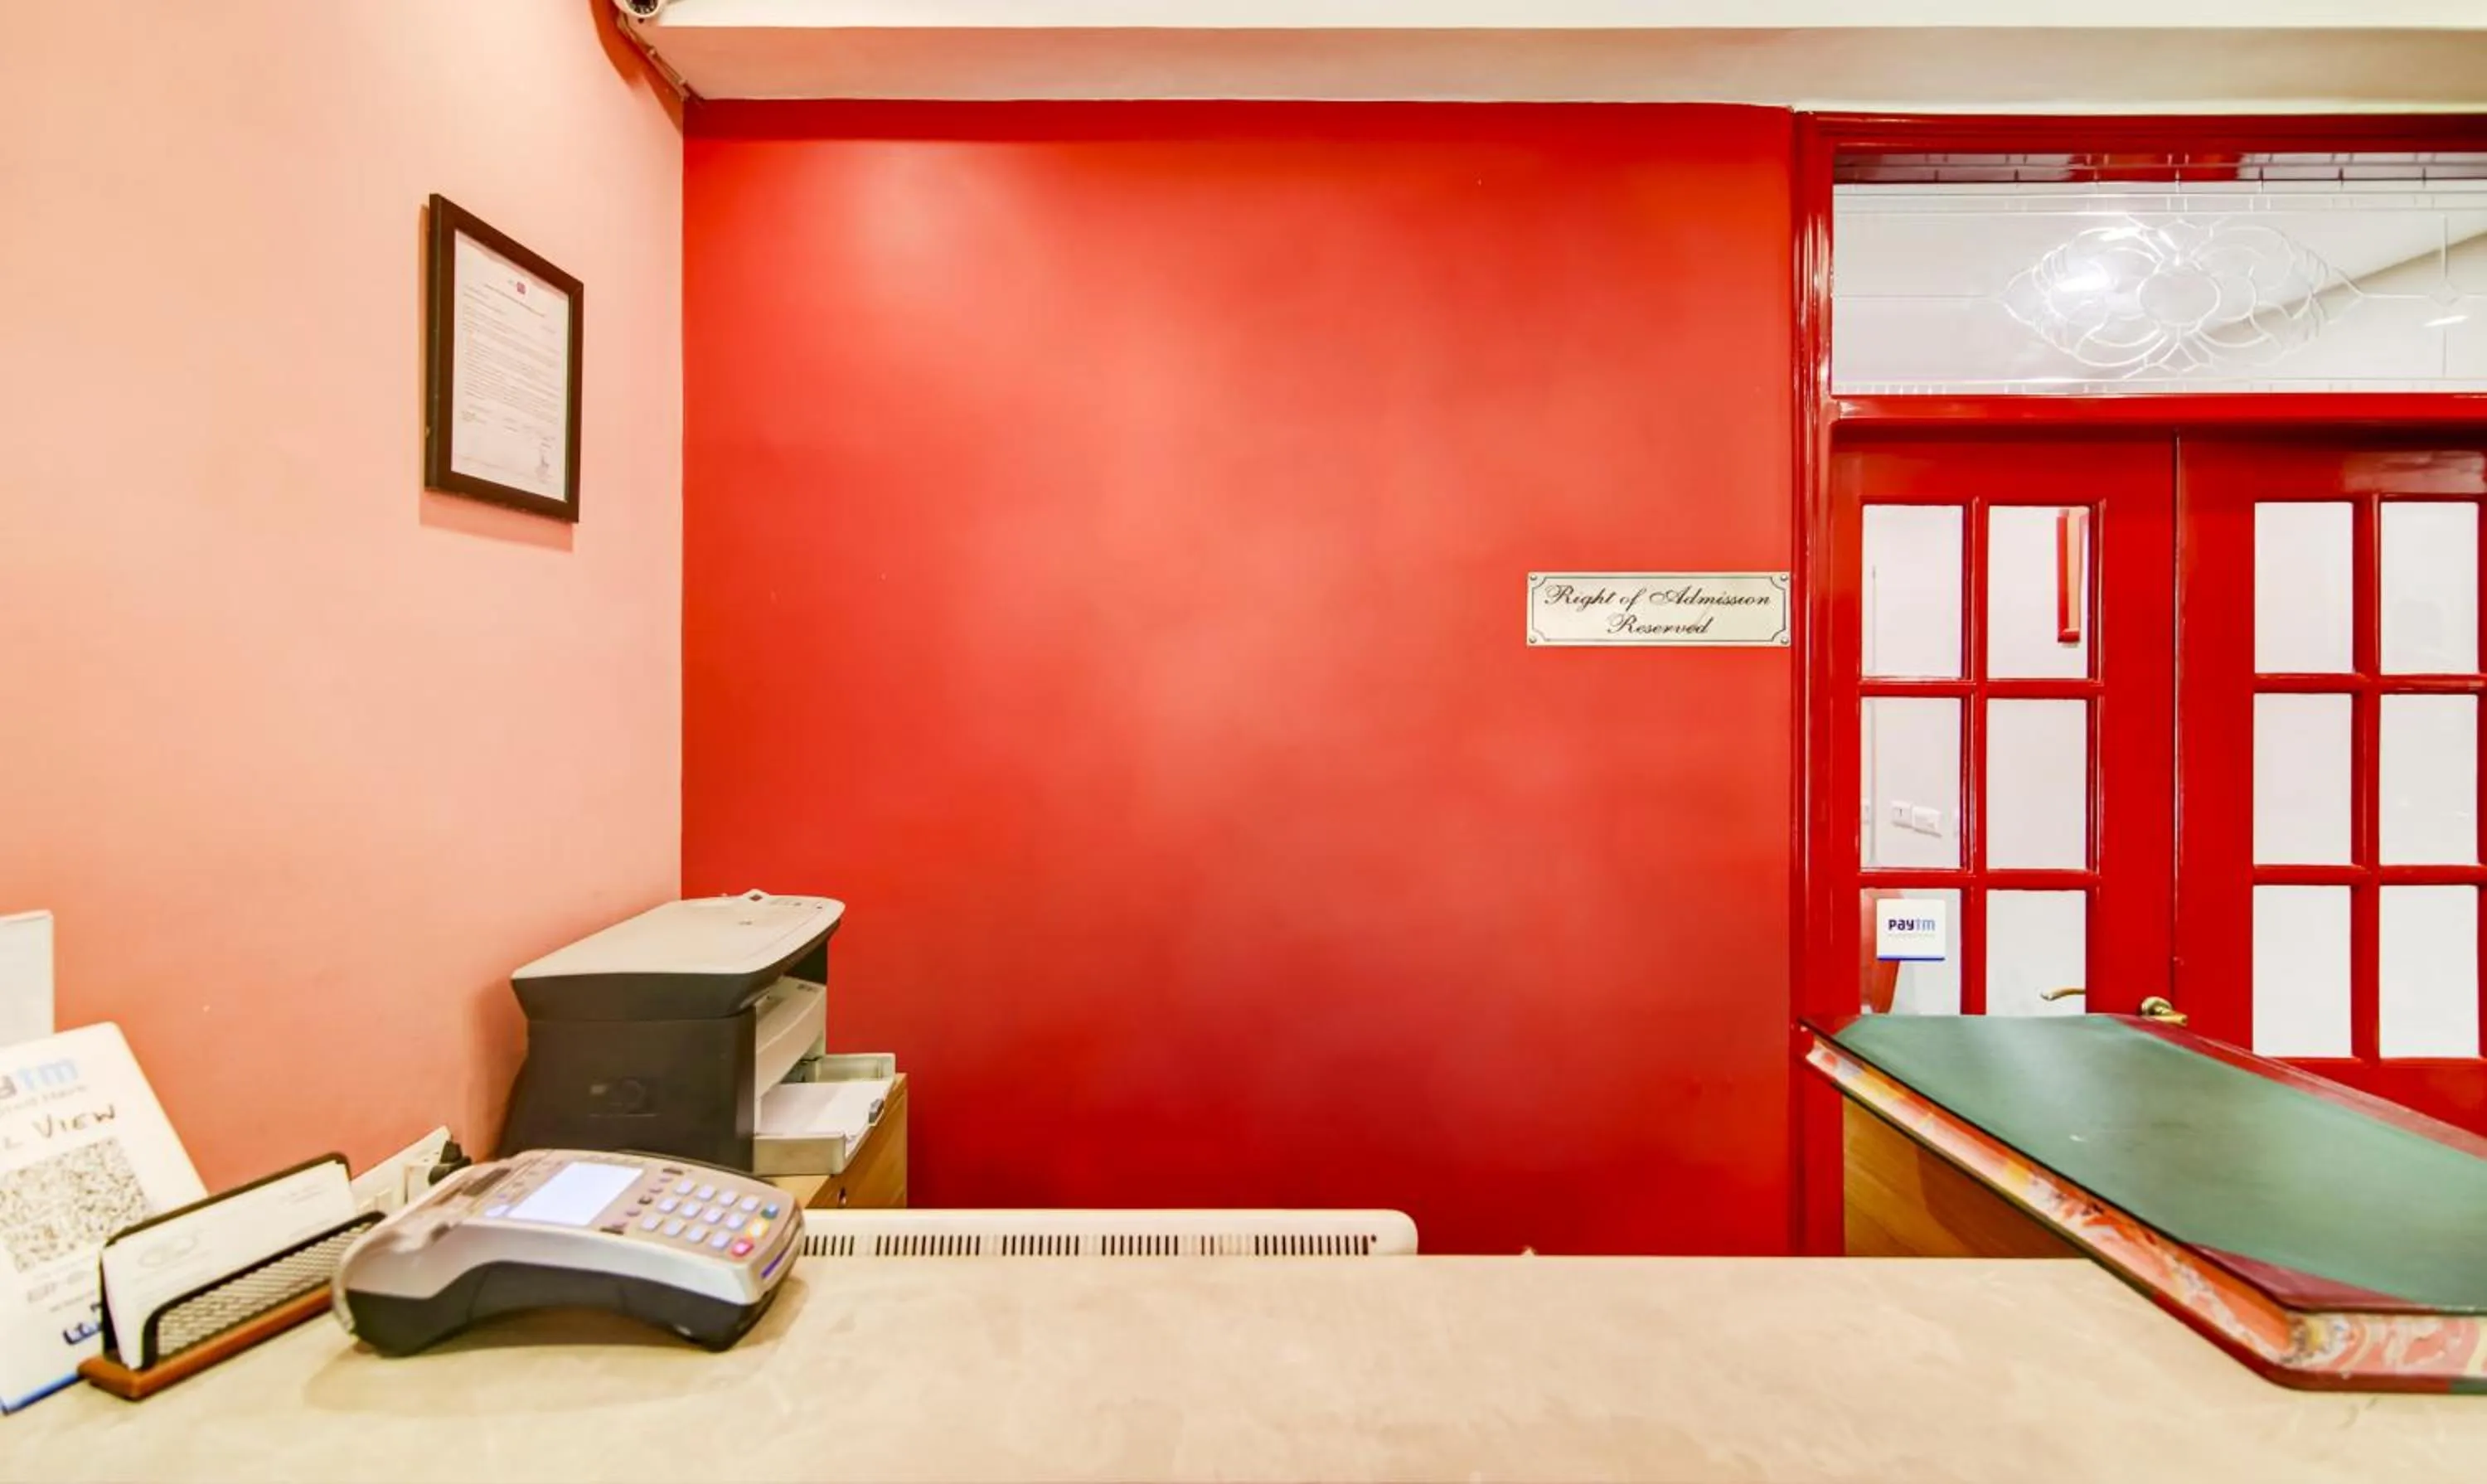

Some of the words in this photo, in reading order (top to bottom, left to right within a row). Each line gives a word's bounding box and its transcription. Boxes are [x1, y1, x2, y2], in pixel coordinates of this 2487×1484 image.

[1544, 584, 1617, 612] Right
[1619, 586, 1647, 612] of
[1649, 584, 1771, 606] Admission
[1606, 613, 1714, 634] Reserved
